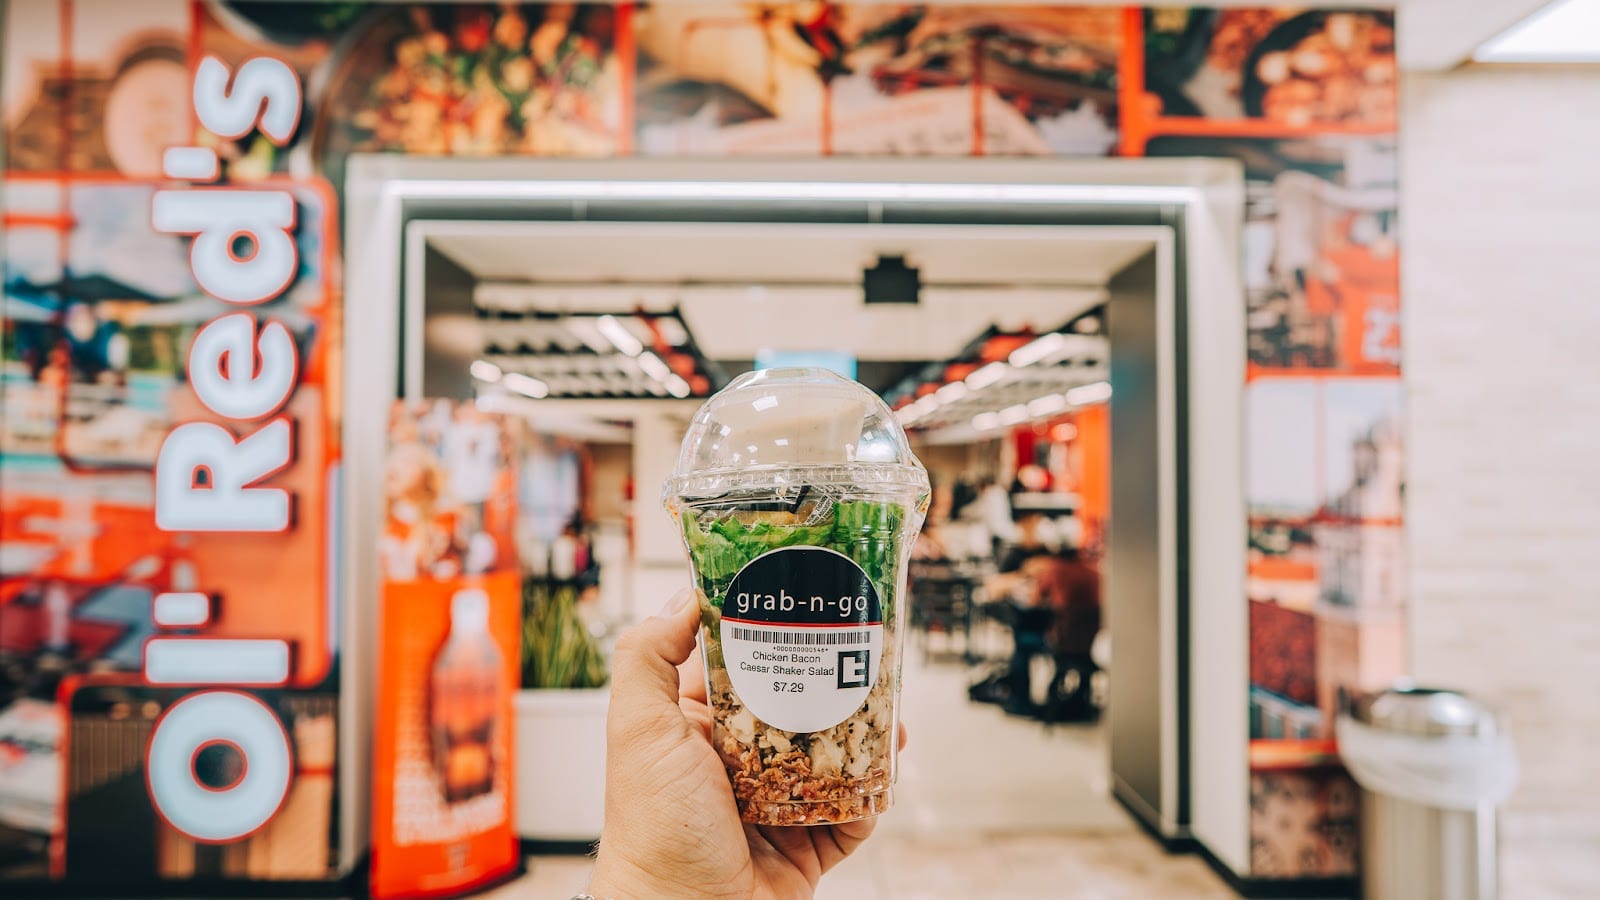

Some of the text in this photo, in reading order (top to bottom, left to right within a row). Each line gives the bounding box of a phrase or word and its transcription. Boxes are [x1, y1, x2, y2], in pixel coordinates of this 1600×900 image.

[145, 55, 300, 843] Ol' Red's
[736, 589, 868, 617] grab-n-go
[752, 651, 821, 663] Chicken Bacon
[740, 661, 834, 676] Caesar Shaker Salad
[773, 681, 804, 693] $7.29
